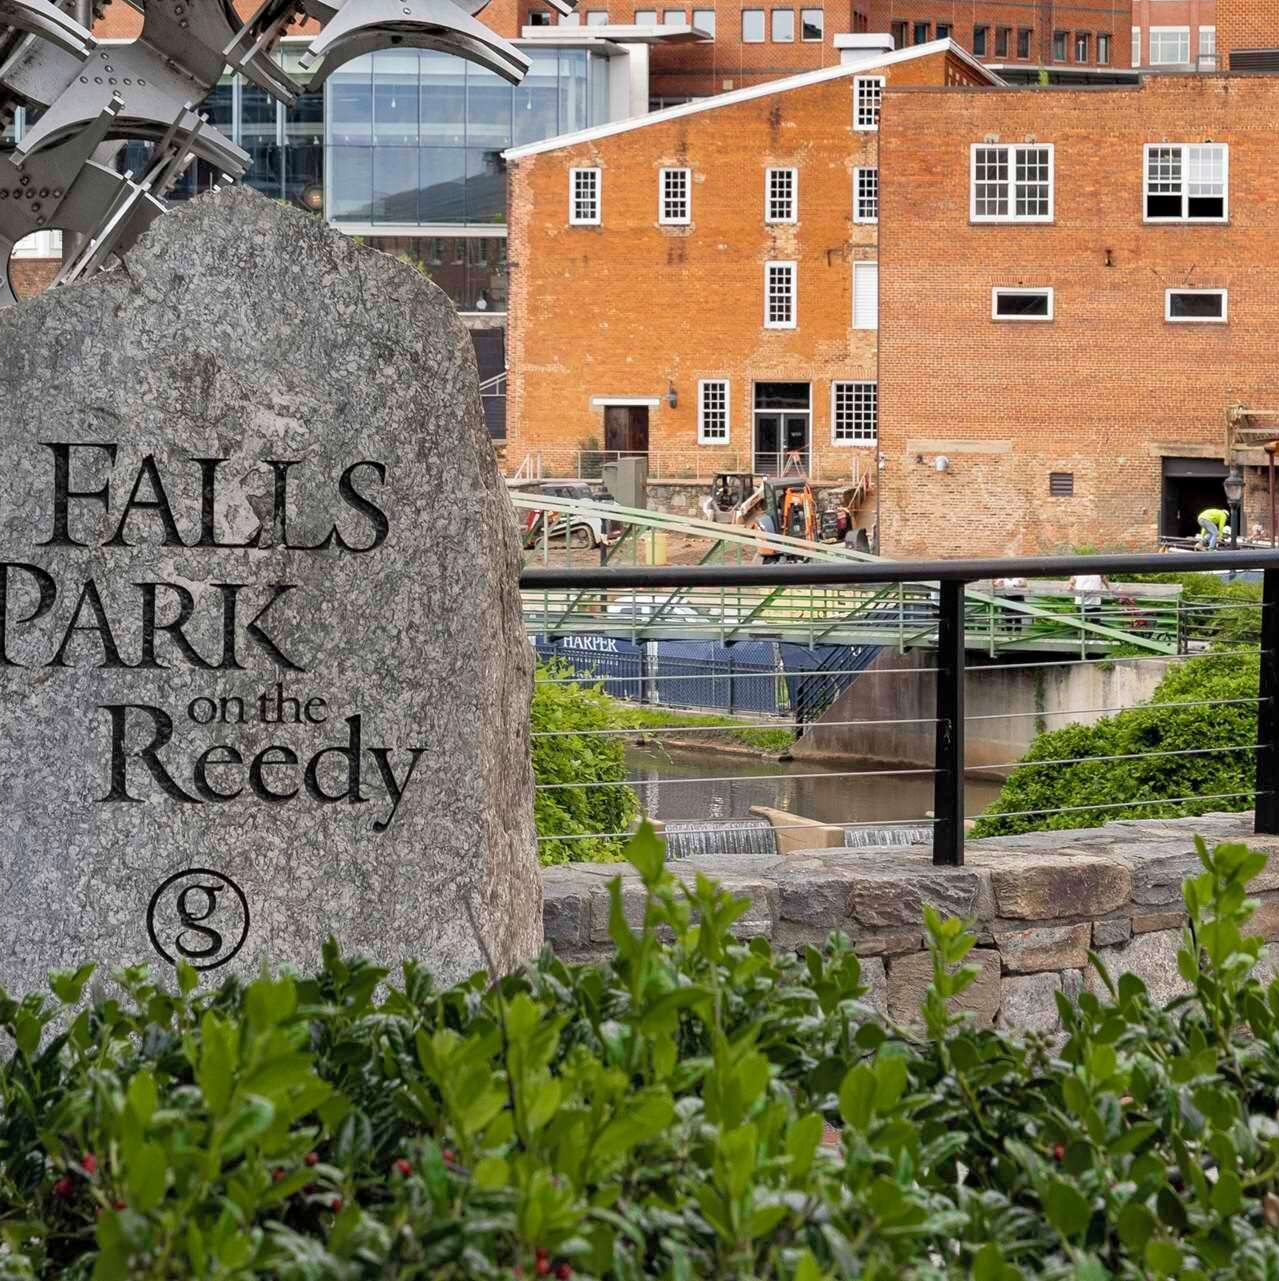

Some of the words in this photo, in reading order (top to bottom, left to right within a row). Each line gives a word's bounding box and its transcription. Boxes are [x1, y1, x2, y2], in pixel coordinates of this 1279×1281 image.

[36, 441, 390, 553] FALLS
[563, 635, 619, 653] HARPER
[187, 692, 246, 723] on
[258, 682, 328, 724] the
[94, 703, 428, 833] Reedy
